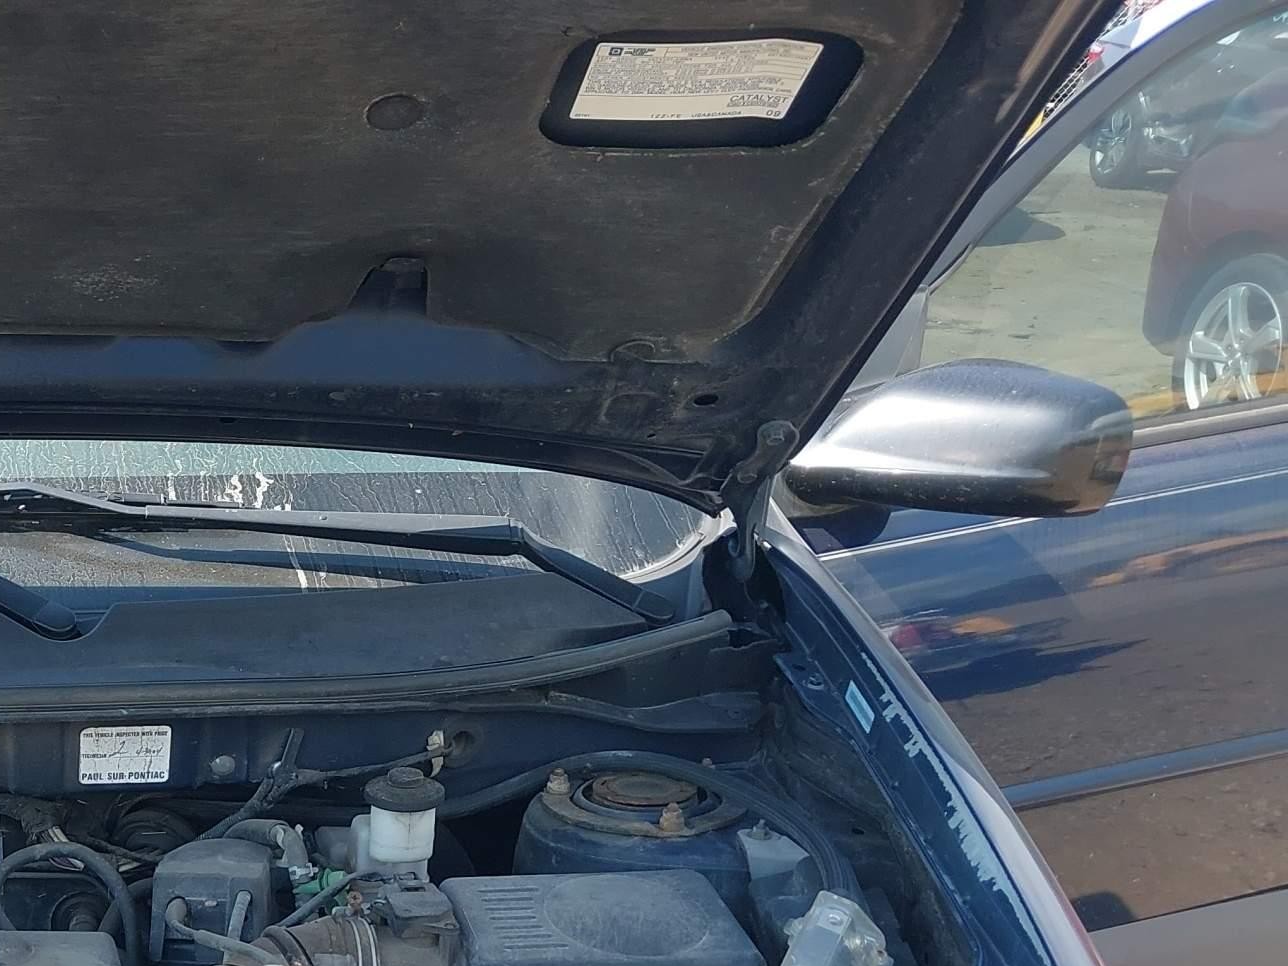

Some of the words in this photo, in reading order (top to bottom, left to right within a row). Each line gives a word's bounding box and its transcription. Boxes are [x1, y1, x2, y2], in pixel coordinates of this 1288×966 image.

[729, 93, 789, 104] CATALYST
[81, 772, 104, 781] PAUL
[128, 771, 165, 780] PONTIAC
